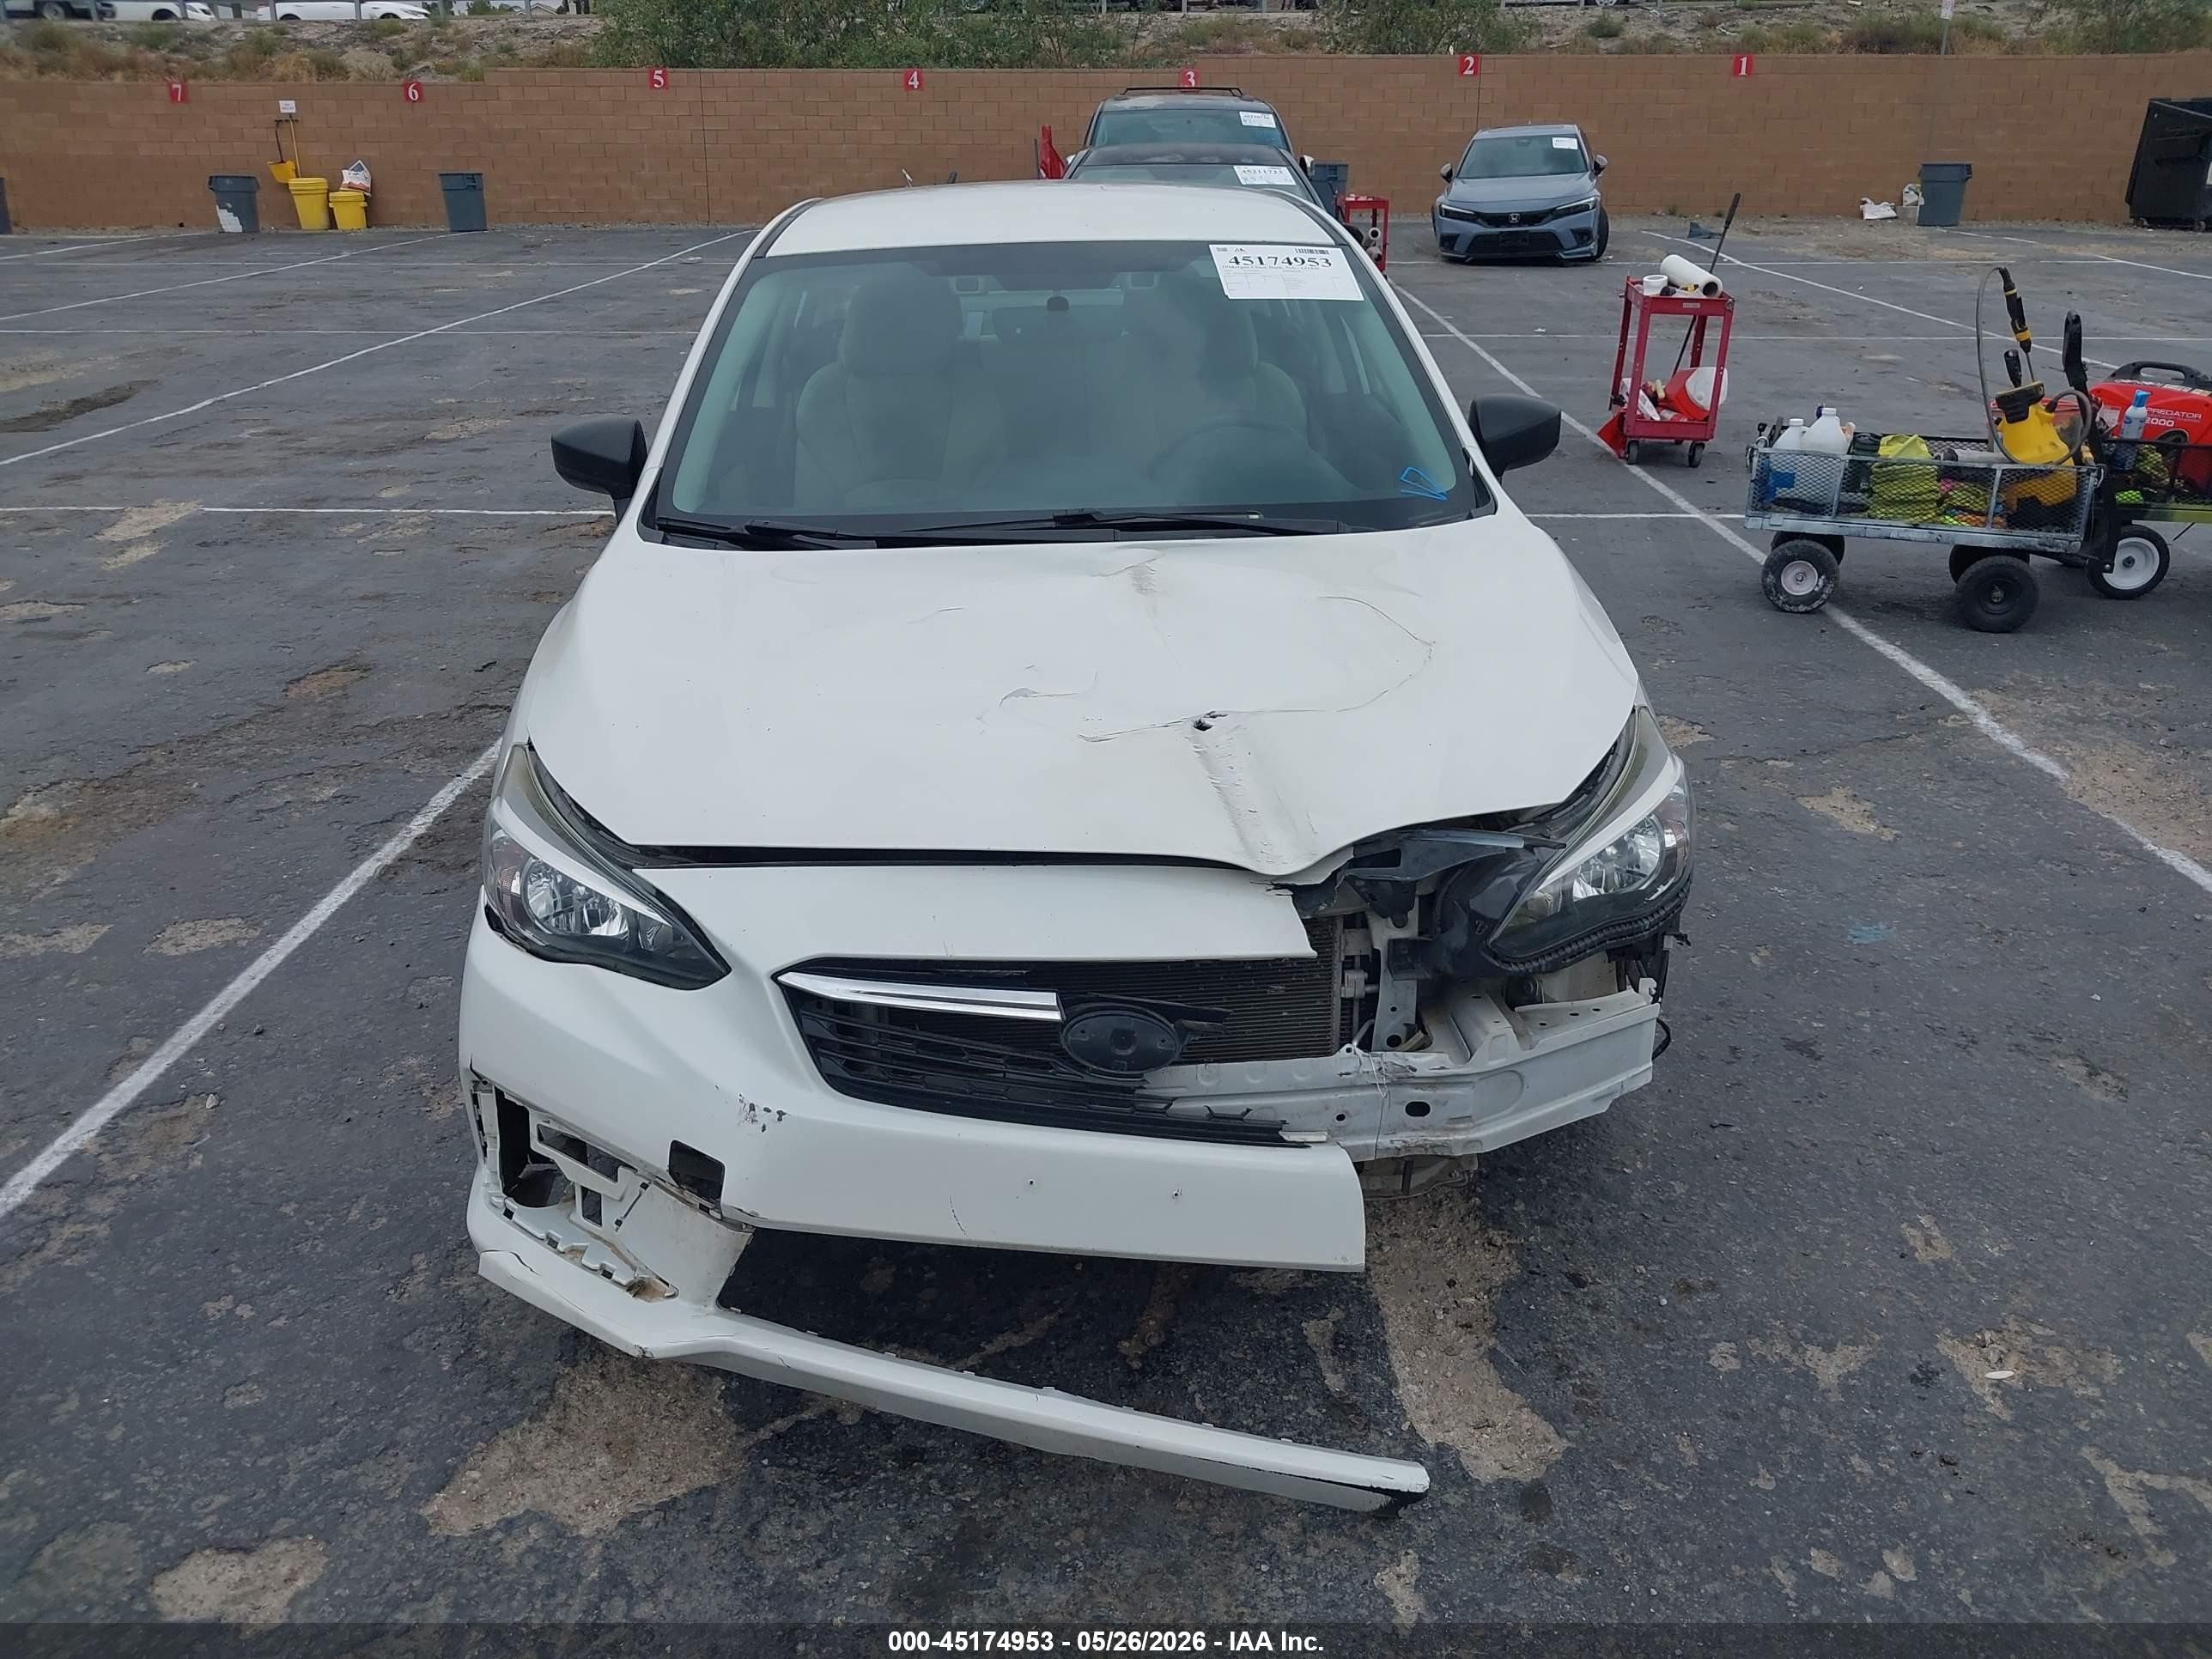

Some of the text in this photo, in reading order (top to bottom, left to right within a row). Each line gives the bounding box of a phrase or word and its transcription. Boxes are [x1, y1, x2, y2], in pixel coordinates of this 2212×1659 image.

[1462, 56, 1475, 75] 2
[1739, 56, 1748, 76] 1
[653, 70, 665, 88] 5
[908, 70, 920, 89] 4
[1184, 70, 1196, 88] 3
[172, 83, 182, 102] 7
[407, 82, 420, 101] 6
[1228, 255, 1333, 268] 45174953
[2145, 406, 2203, 420] PREDATOR
[2145, 416, 2175, 427] 2000
